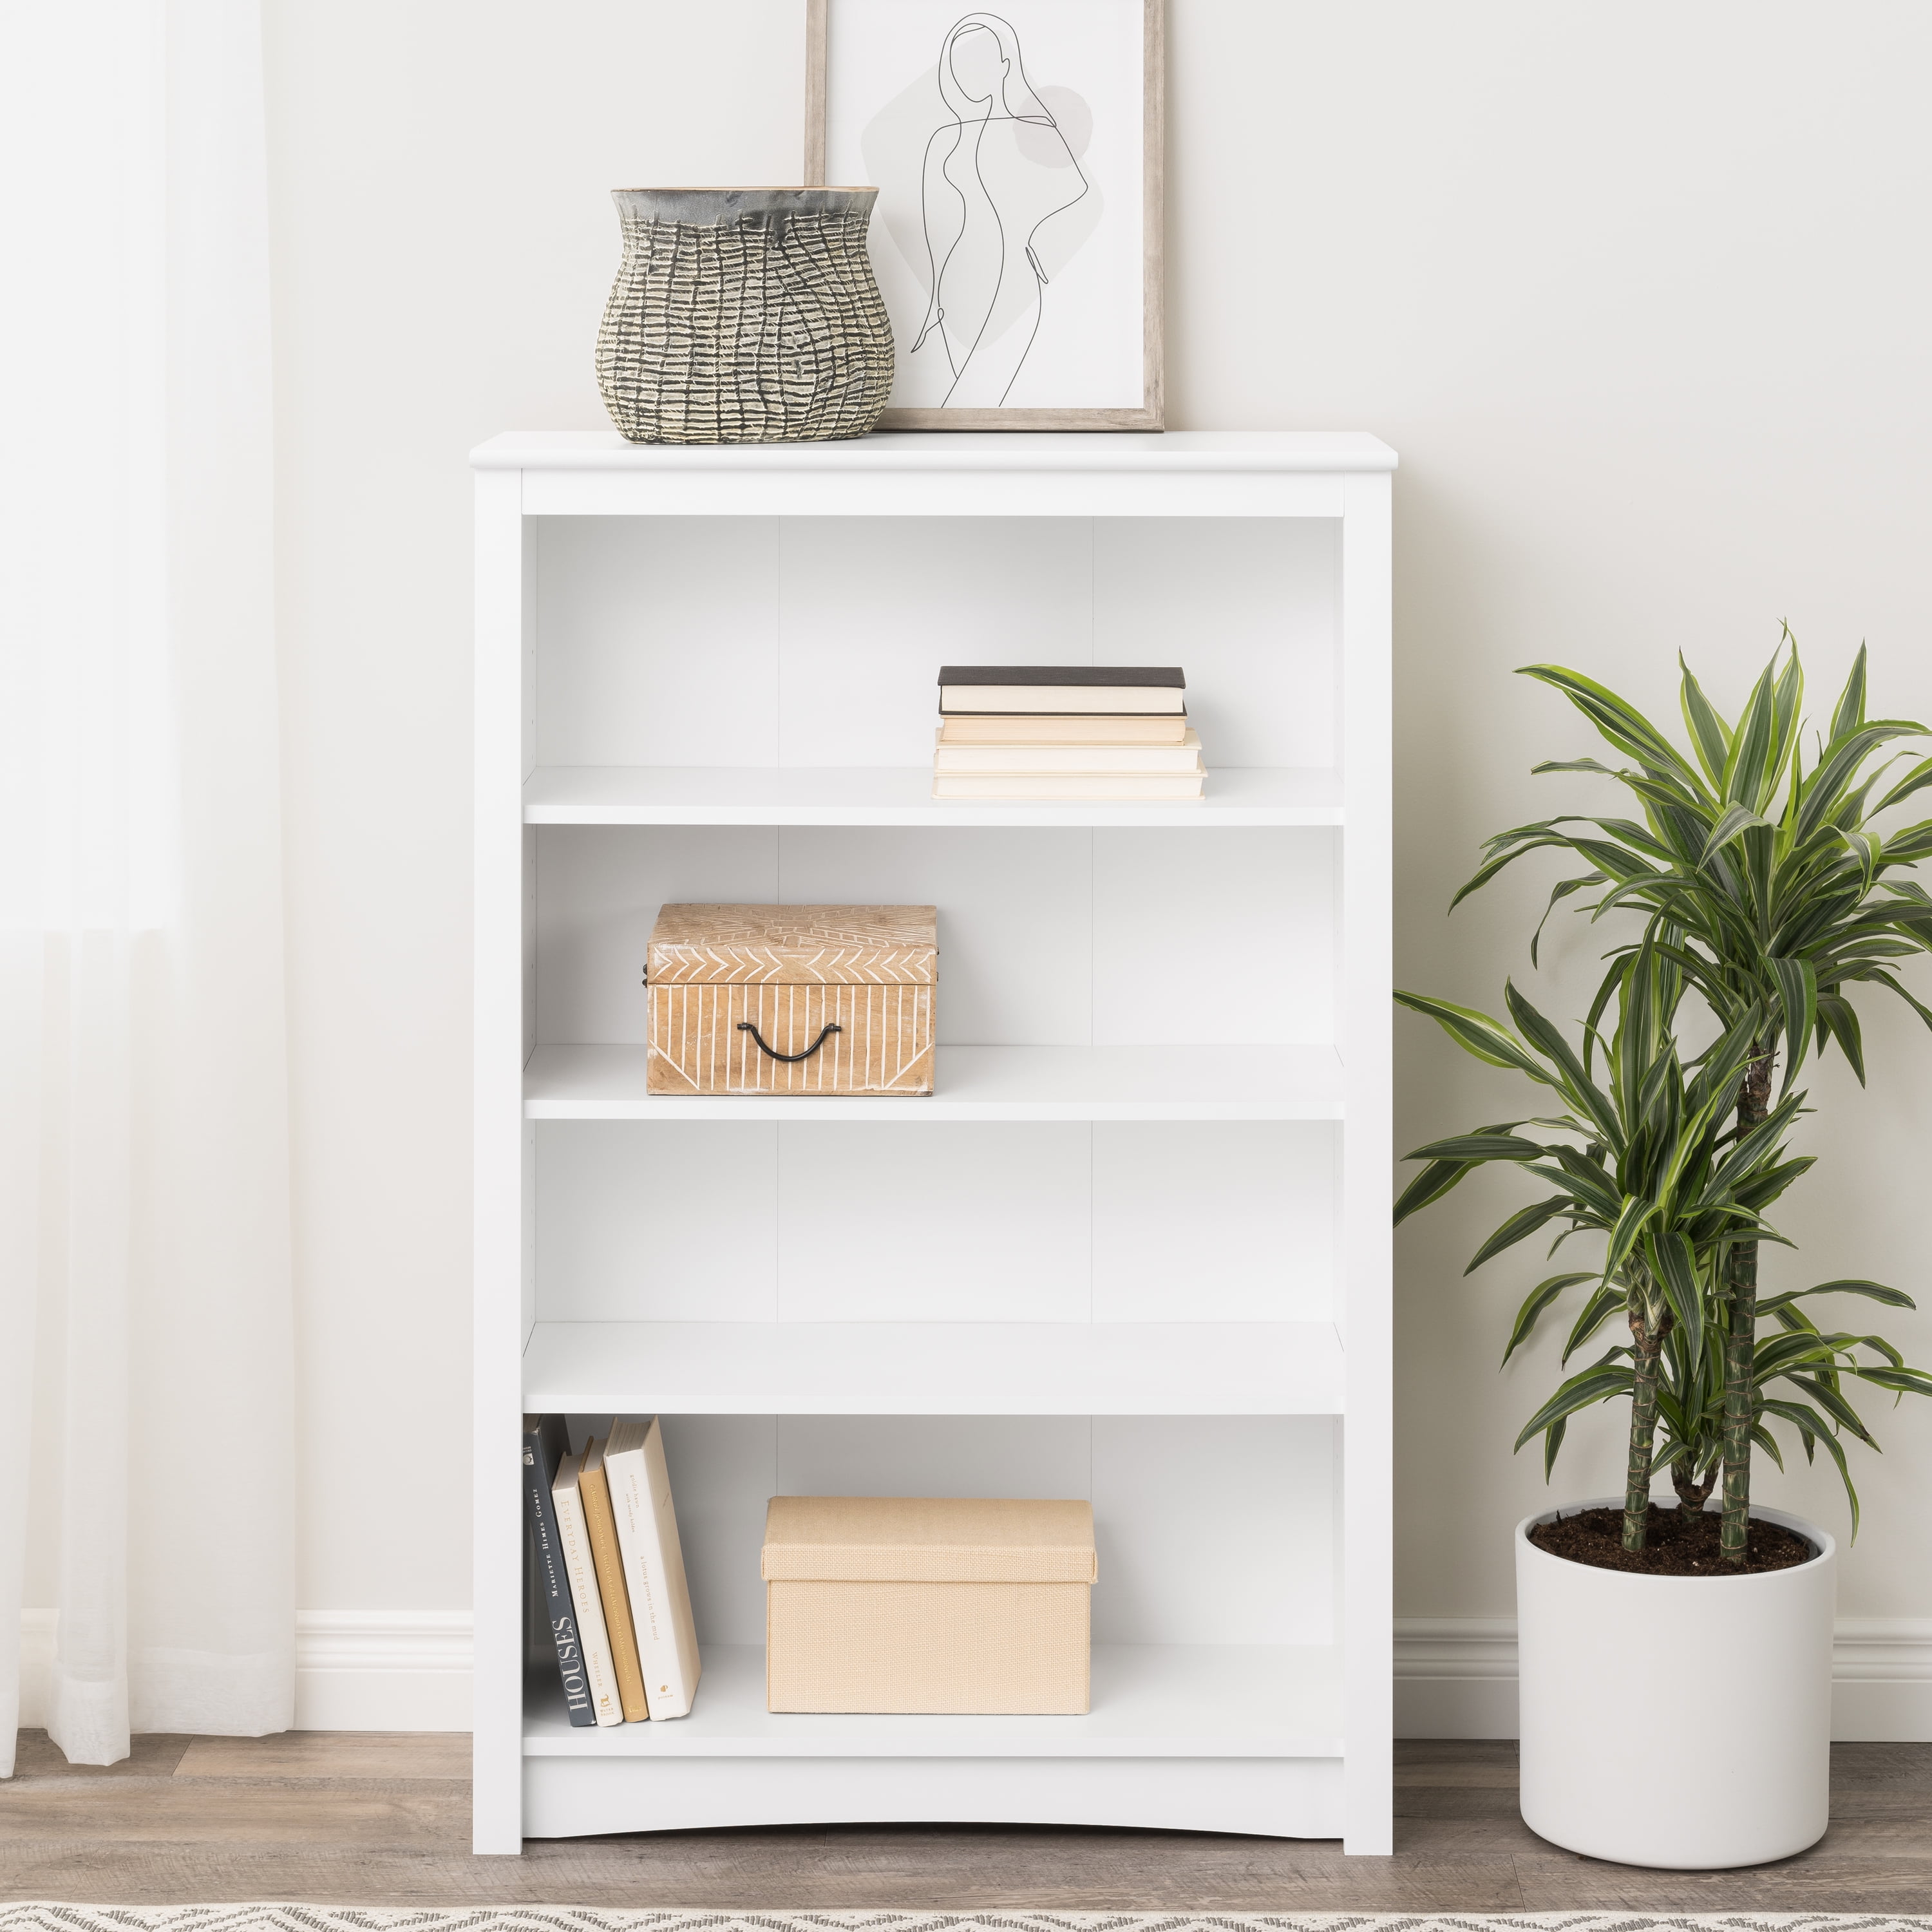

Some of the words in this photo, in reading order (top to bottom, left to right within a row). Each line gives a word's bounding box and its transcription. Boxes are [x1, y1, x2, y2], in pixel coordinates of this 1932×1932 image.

[643, 1580, 651, 1601] grows
[553, 1616, 588, 1711] HOUSES
[592, 1652, 603, 1687] WHEELER
